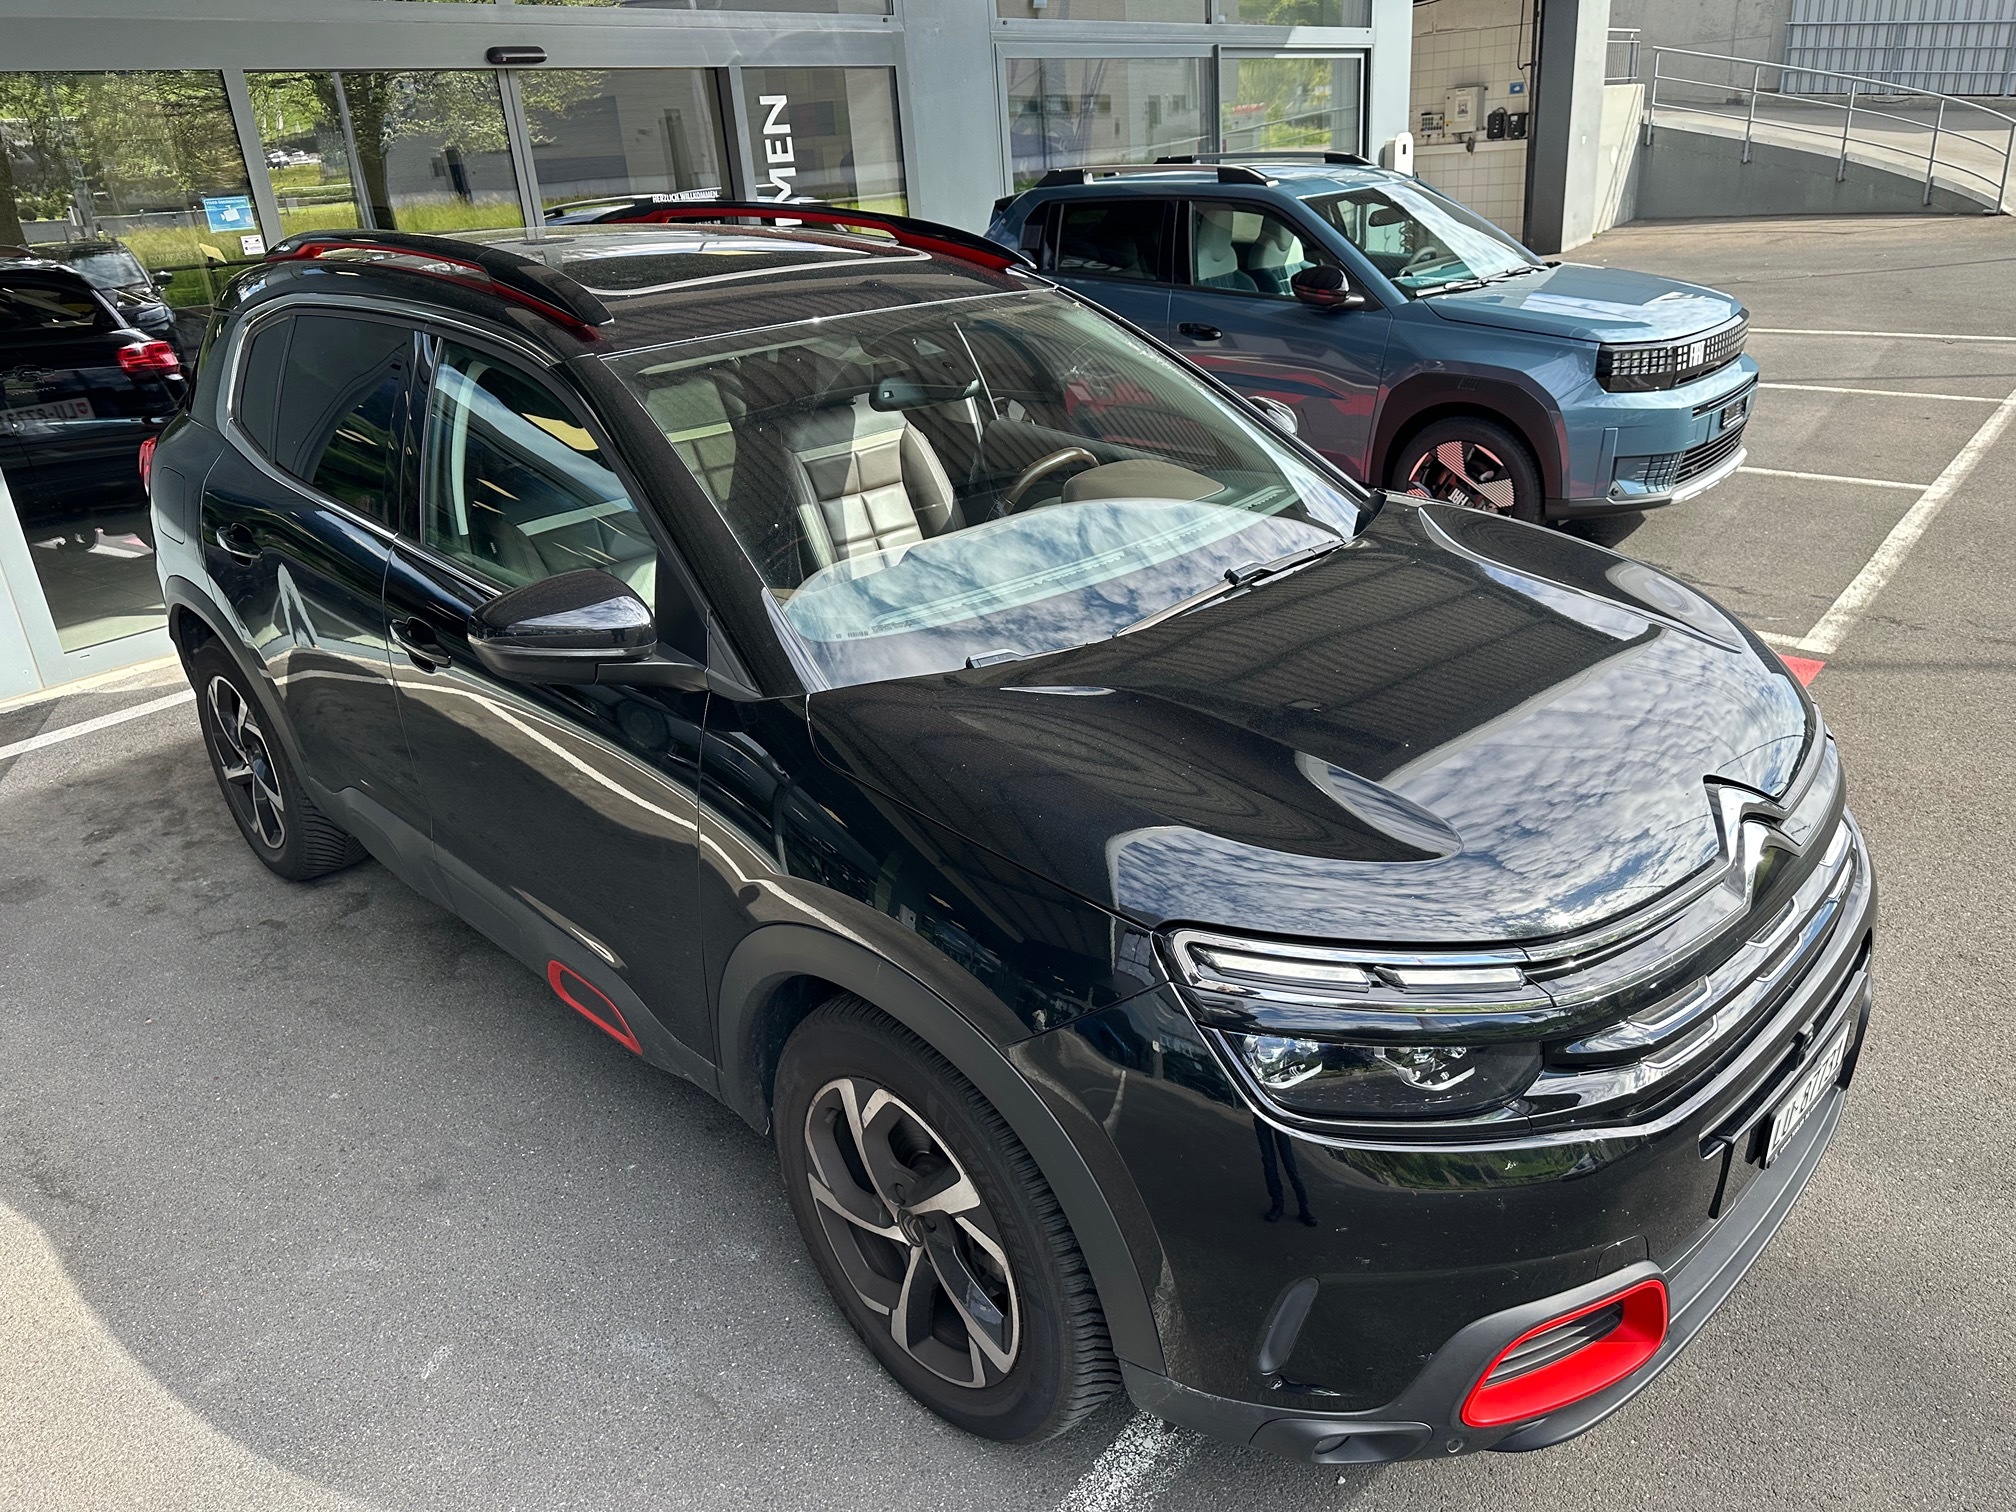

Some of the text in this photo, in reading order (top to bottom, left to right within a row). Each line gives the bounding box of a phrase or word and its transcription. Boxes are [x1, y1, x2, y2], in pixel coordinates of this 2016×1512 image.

[148, 252, 193, 263] COMPASS
[1689, 341, 1706, 367] FIAT
[1448, 488, 1469, 506] FIAT
[961, 1147, 1040, 1302] MICHELIN
